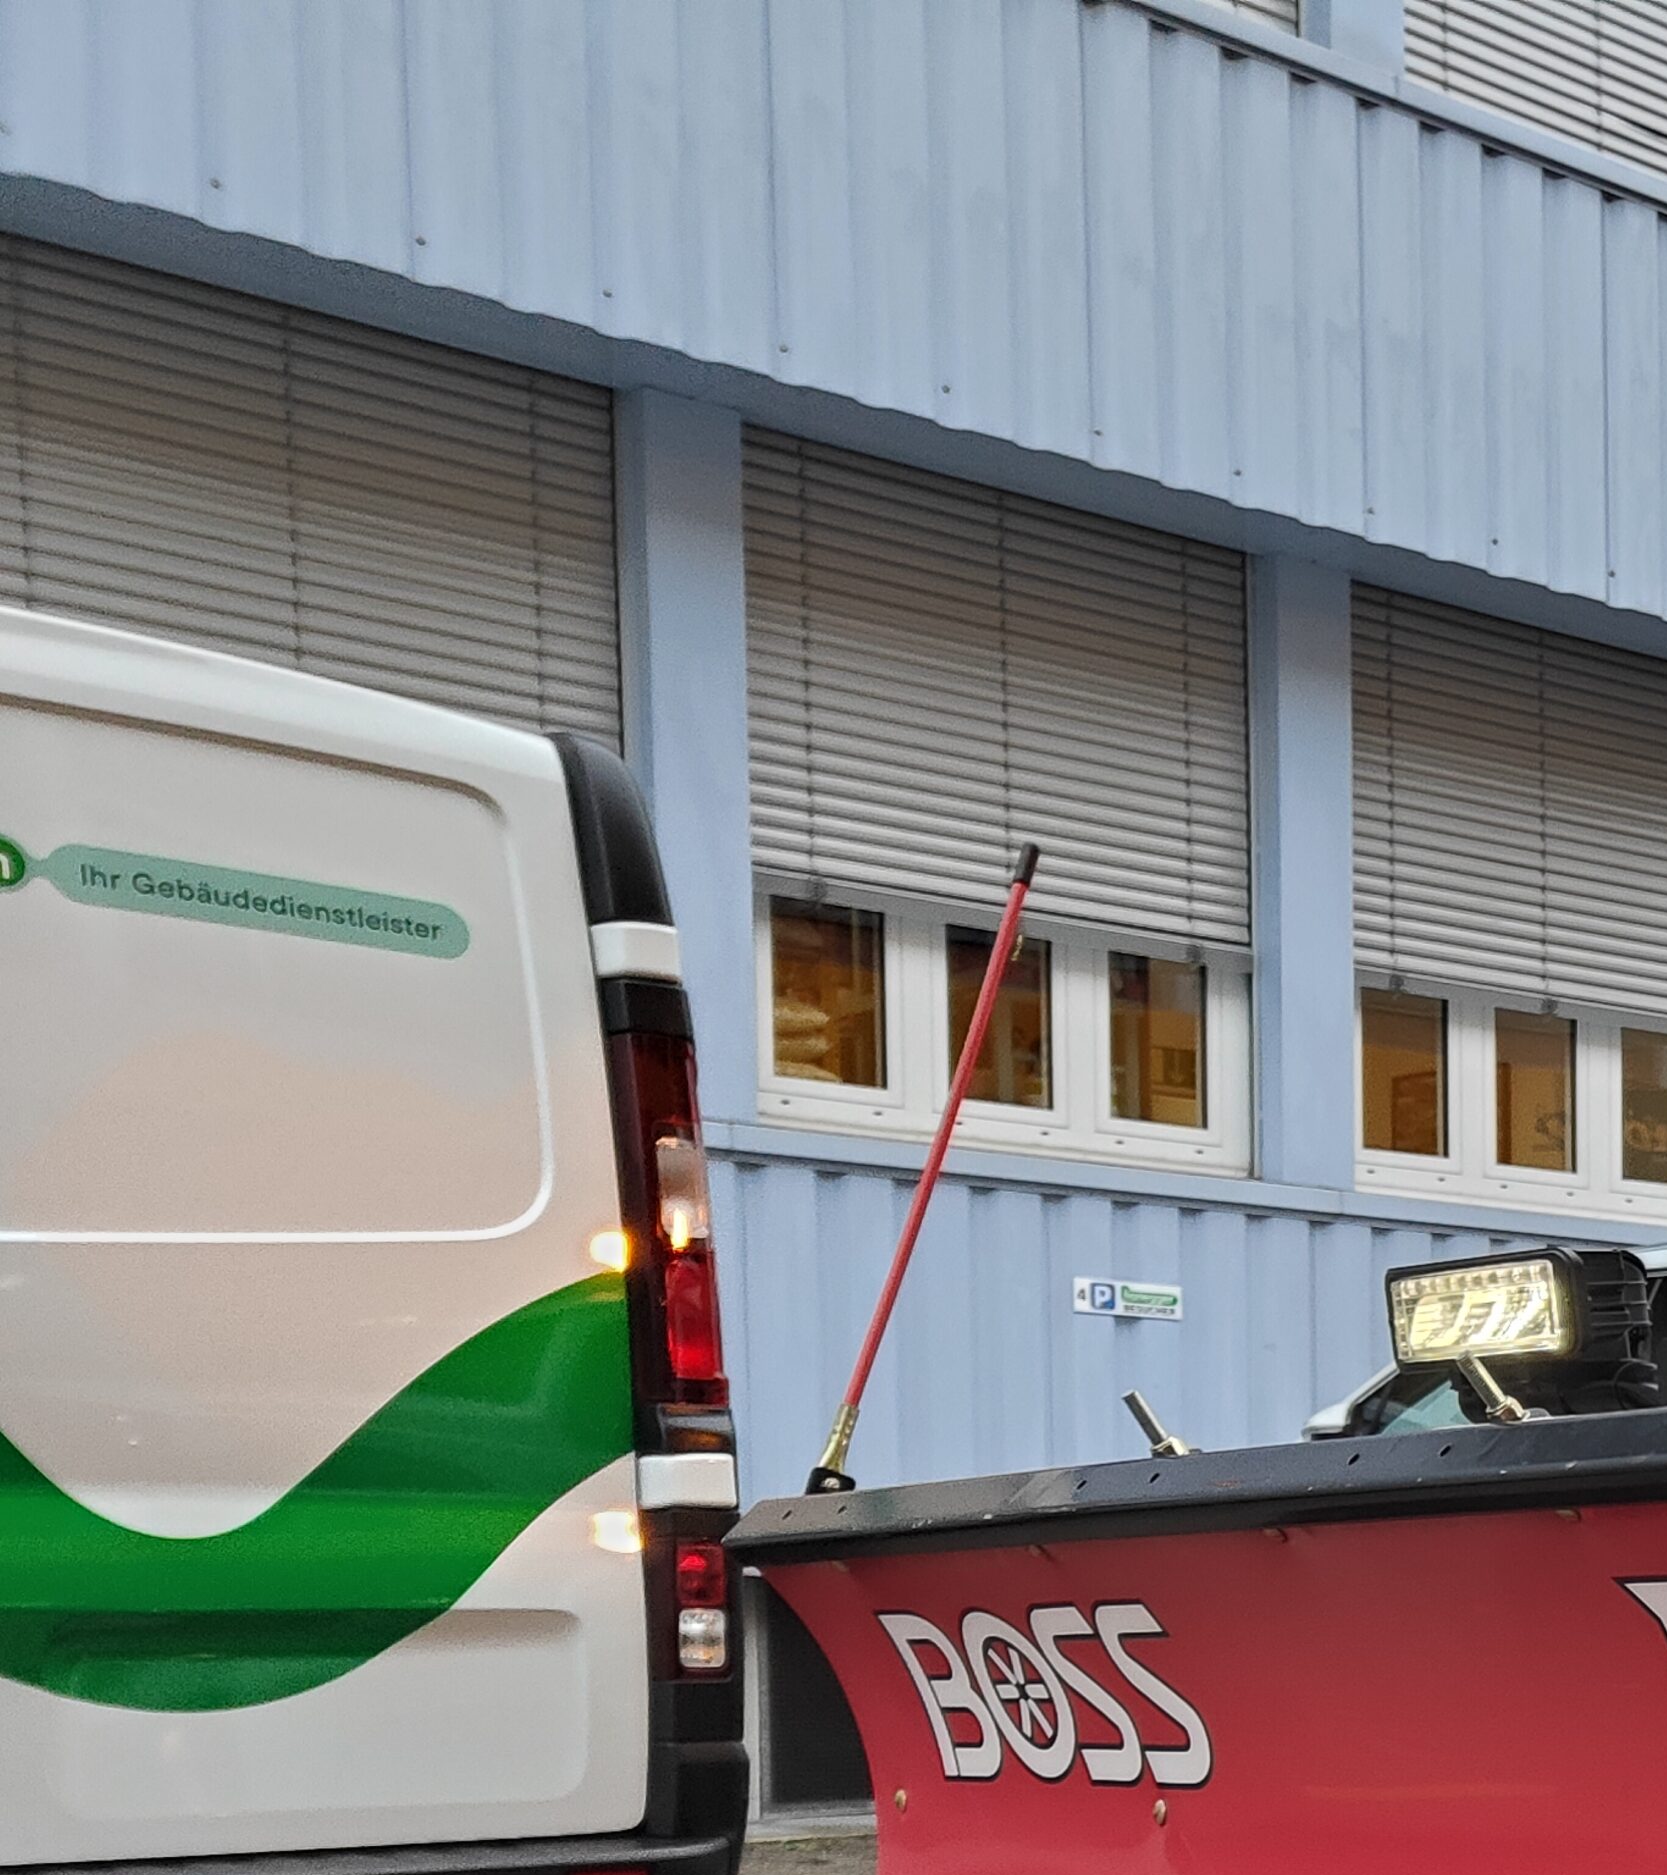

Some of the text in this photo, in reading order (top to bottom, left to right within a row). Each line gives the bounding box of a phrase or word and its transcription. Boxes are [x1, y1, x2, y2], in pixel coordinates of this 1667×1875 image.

[80, 863, 442, 942] Ihr Gebäudedienstleister
[875, 1600, 1213, 1789] BOSS
